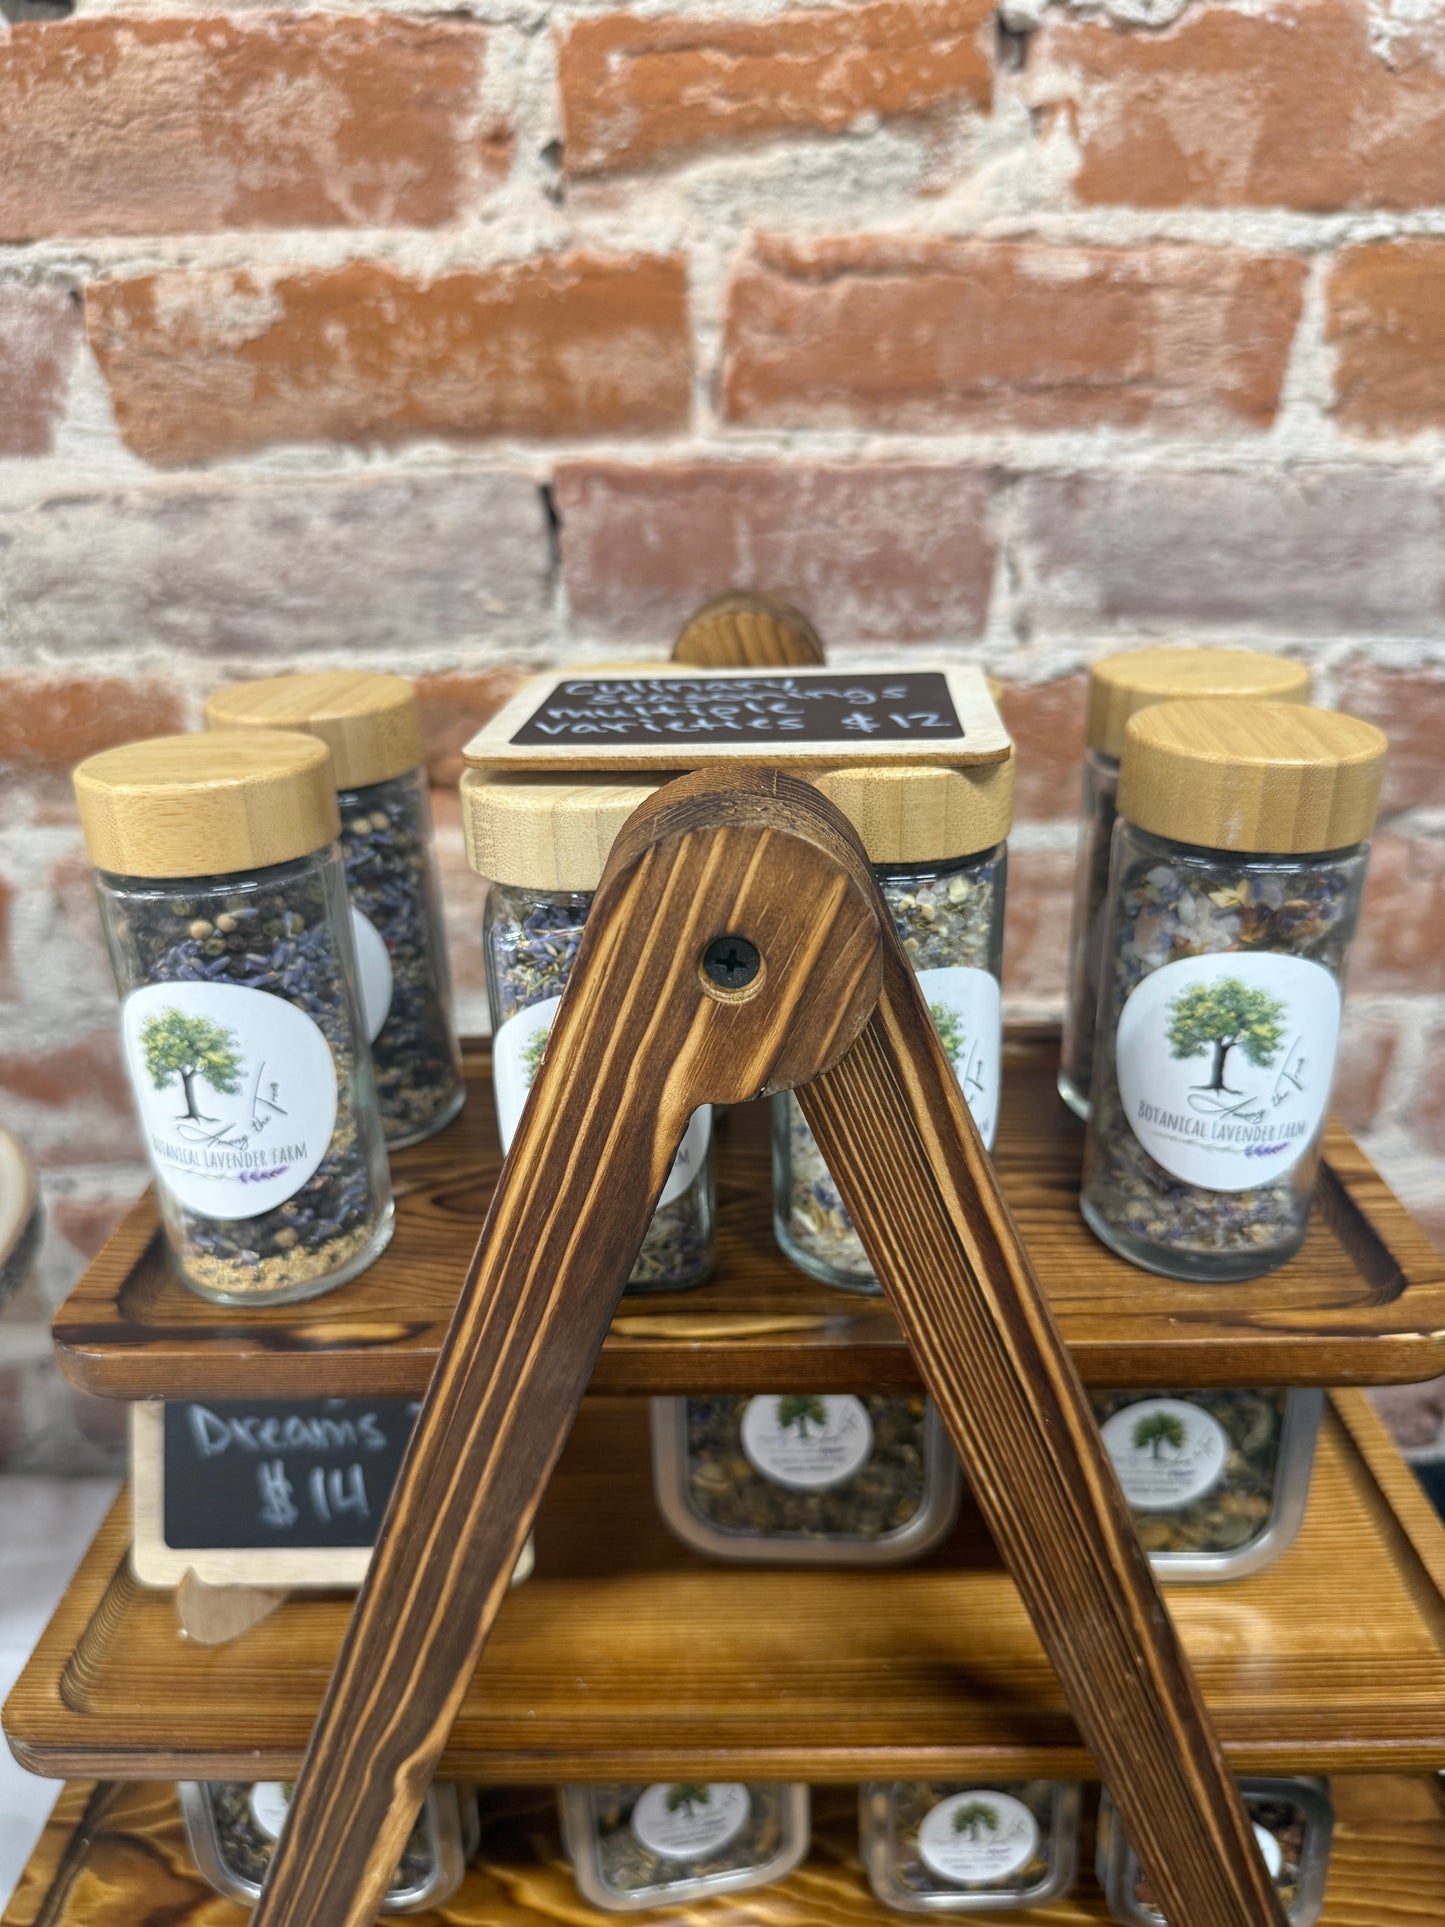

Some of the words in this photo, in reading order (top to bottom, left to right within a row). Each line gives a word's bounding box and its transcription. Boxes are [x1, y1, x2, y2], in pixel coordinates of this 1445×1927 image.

[547, 701, 805, 721] multiple
[1137, 1099, 1206, 1138] BOTANICAL
[203, 1147, 268, 1169] LAVENDER
[272, 1140, 308, 1165] FARM
[188, 1403, 388, 1456] Dreams
